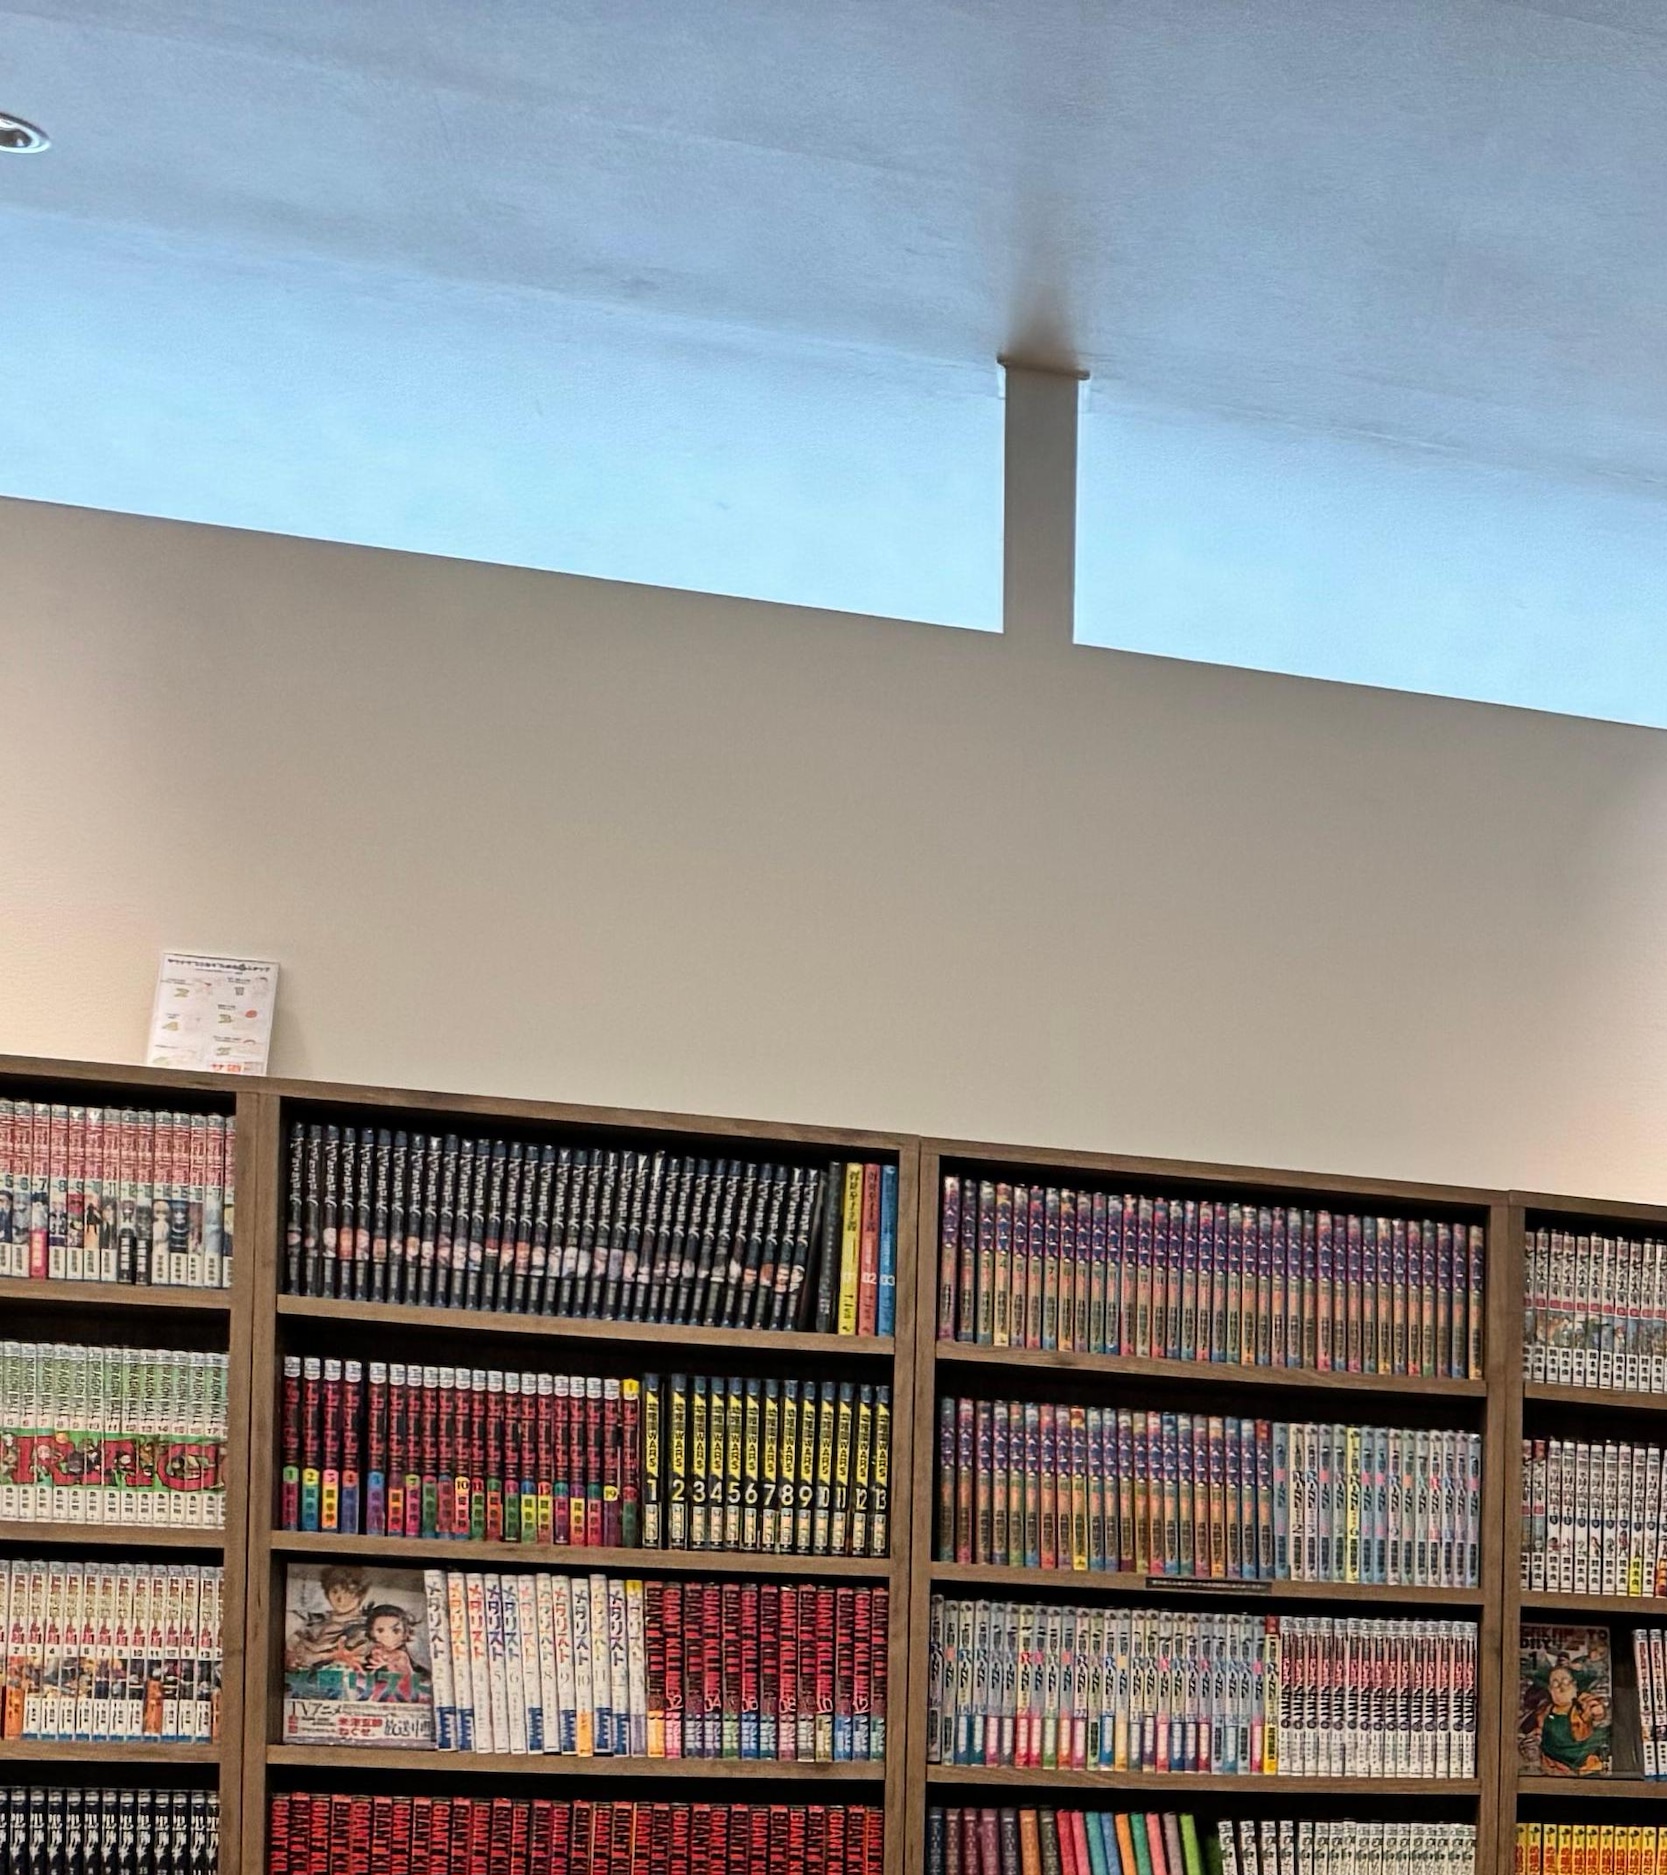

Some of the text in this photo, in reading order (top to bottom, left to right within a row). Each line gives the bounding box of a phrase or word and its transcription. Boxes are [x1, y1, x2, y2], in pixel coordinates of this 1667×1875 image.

[673, 1480, 685, 1500] 2
[693, 1481, 705, 1502] 3
[711, 1481, 722, 1502] 4
[781, 1484, 793, 1505] 8
[800, 1486, 812, 1507] 9
